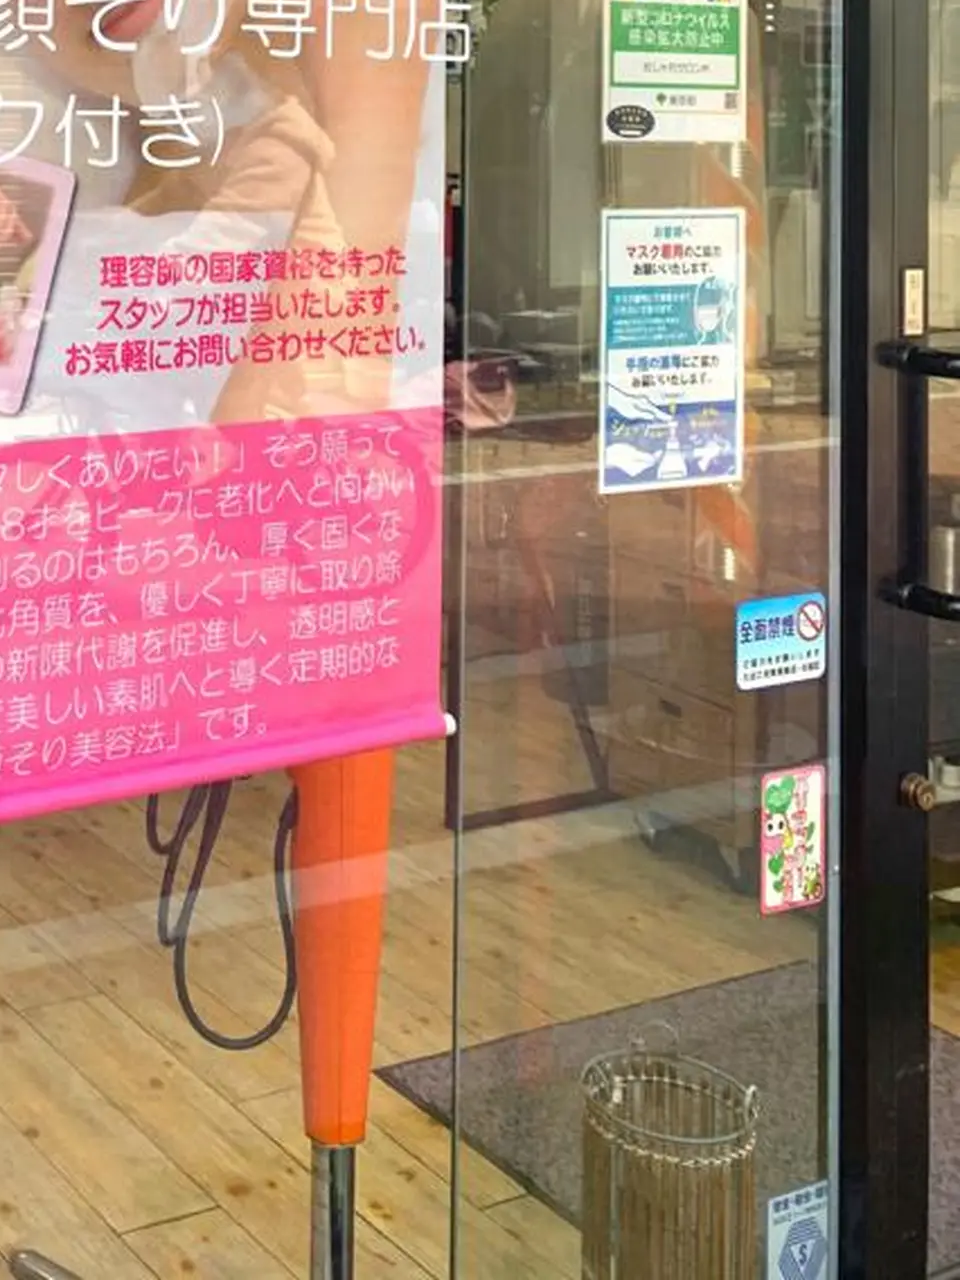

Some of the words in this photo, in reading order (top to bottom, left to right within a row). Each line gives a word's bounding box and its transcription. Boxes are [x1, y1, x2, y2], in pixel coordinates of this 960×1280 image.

[100, 244, 407, 289] 理容師の国家資格を持った
[97, 285, 400, 332] スタッフが担当いたします。
[65, 325, 427, 377] お気軽にお問い合わせください。
[740, 614, 795, 644] 全面禁煙
